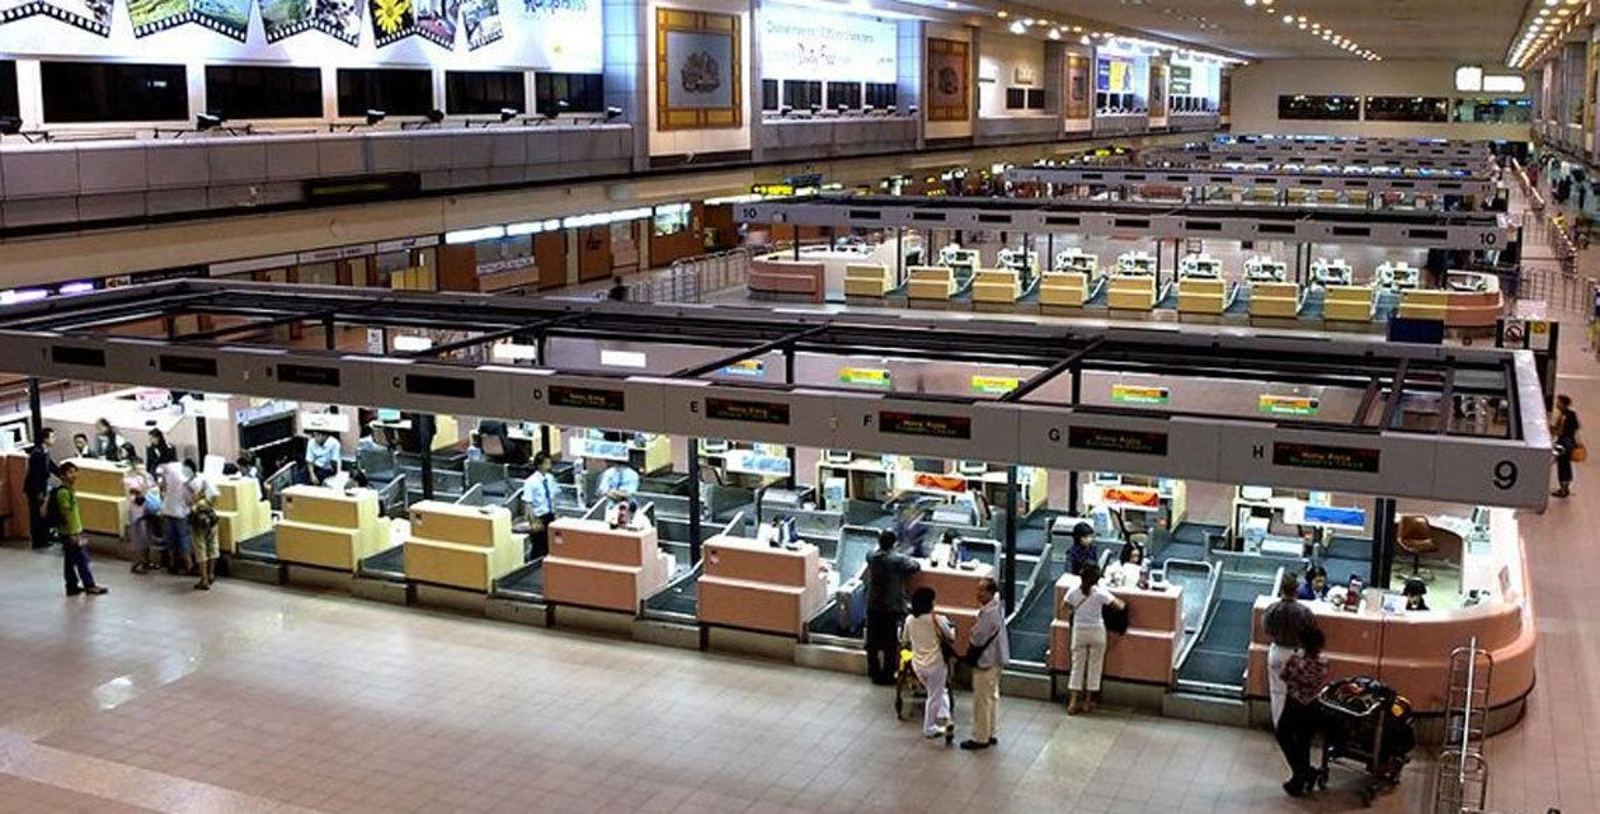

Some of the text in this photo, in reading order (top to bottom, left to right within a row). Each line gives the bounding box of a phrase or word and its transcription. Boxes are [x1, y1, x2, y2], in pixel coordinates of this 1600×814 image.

[743, 207, 757, 218] 10
[1480, 232, 1497, 245] 10
[148, 357, 157, 370] A
[391, 376, 401, 389] C
[533, 388, 543, 400] D
[690, 401, 699, 413] E
[863, 414, 873, 427] F
[1048, 430, 1060, 442] G
[1252, 445, 1264, 458] H
[1493, 460, 1518, 490] 9
